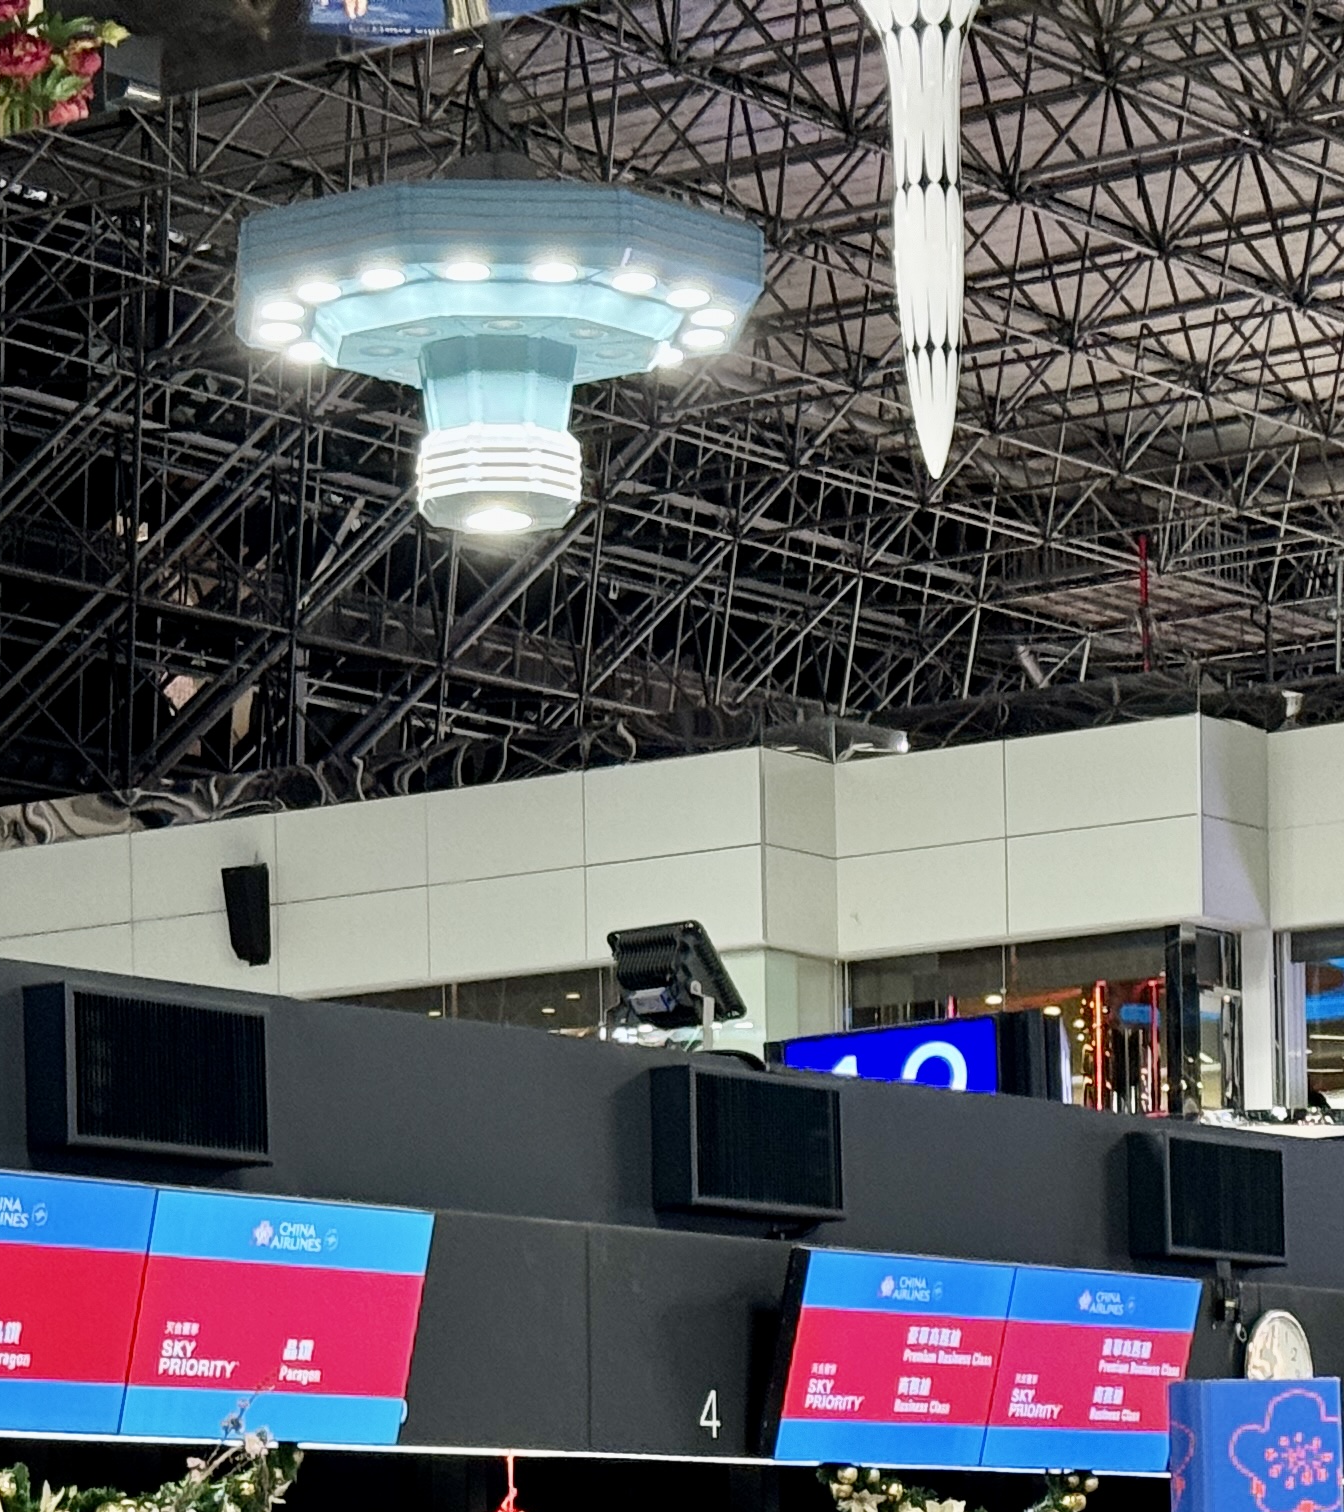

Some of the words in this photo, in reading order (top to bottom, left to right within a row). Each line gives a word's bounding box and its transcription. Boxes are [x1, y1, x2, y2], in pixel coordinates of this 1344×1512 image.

[279, 1221, 316, 1238] CHINA
[270, 1235, 322, 1252] AIRLINES
[899, 1276, 927, 1290] CHINA
[891, 1288, 930, 1302] AIRLINES
[161, 1339, 197, 1358] SKY
[158, 1357, 236, 1379] PRIORITY
[278, 1364, 322, 1386] Paragon
[808, 1378, 834, 1394] SKY
[805, 1394, 863, 1412] PRIORITY
[1011, 1388, 1036, 1404] SKY
[699, 1389, 721, 1439] 4
